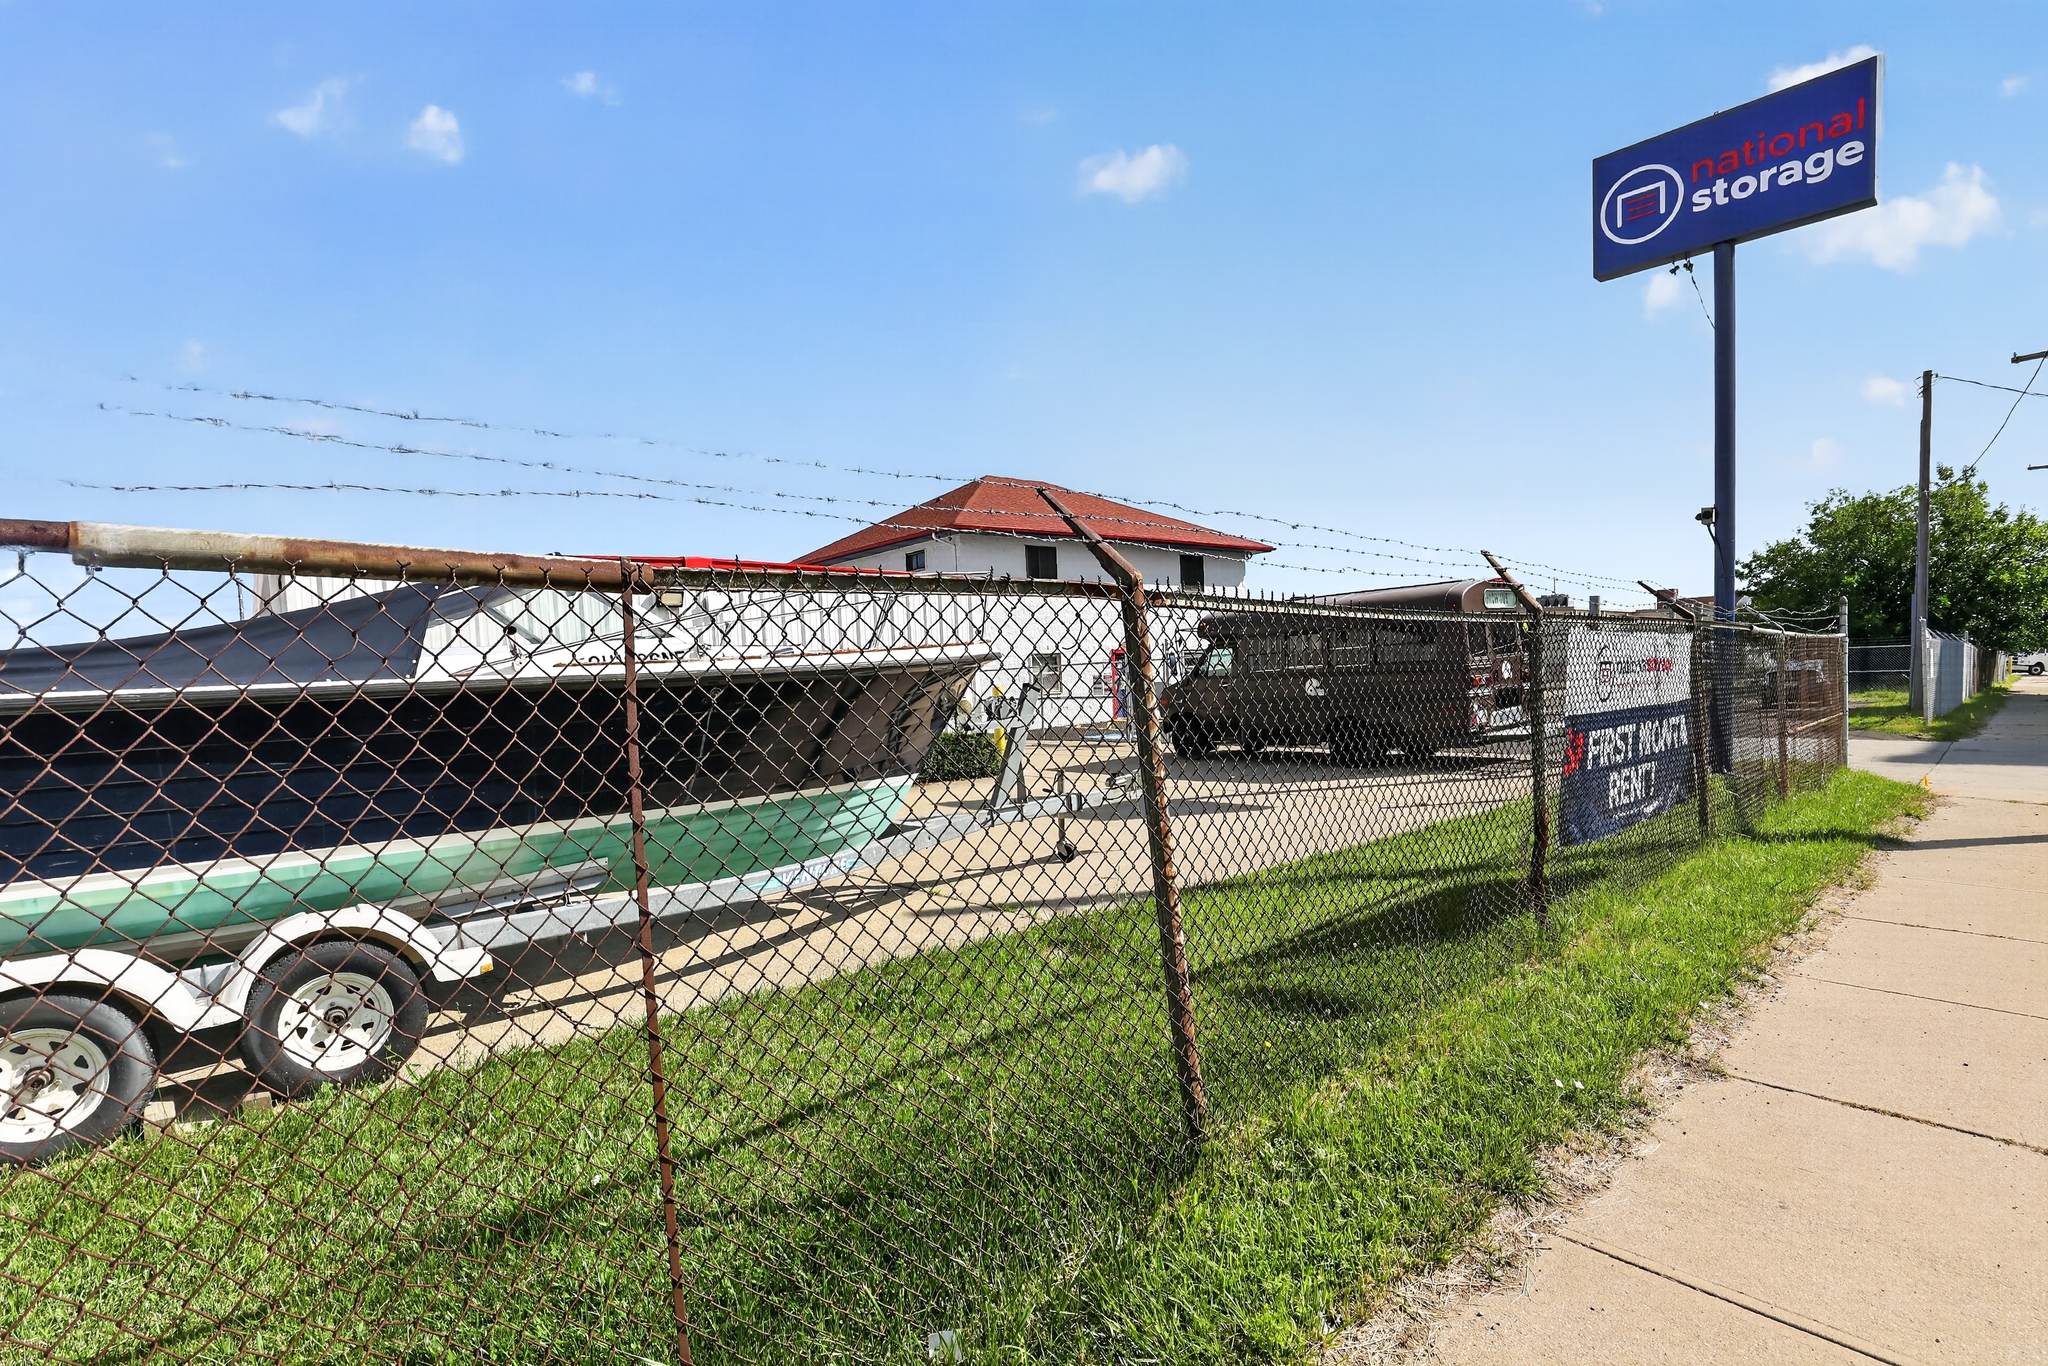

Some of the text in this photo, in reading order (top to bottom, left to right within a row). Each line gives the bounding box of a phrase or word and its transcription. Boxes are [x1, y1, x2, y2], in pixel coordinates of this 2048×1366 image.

[1692, 97, 1865, 183] national
[1692, 140, 1865, 213] storage
[1587, 723, 1637, 770] FIRST
